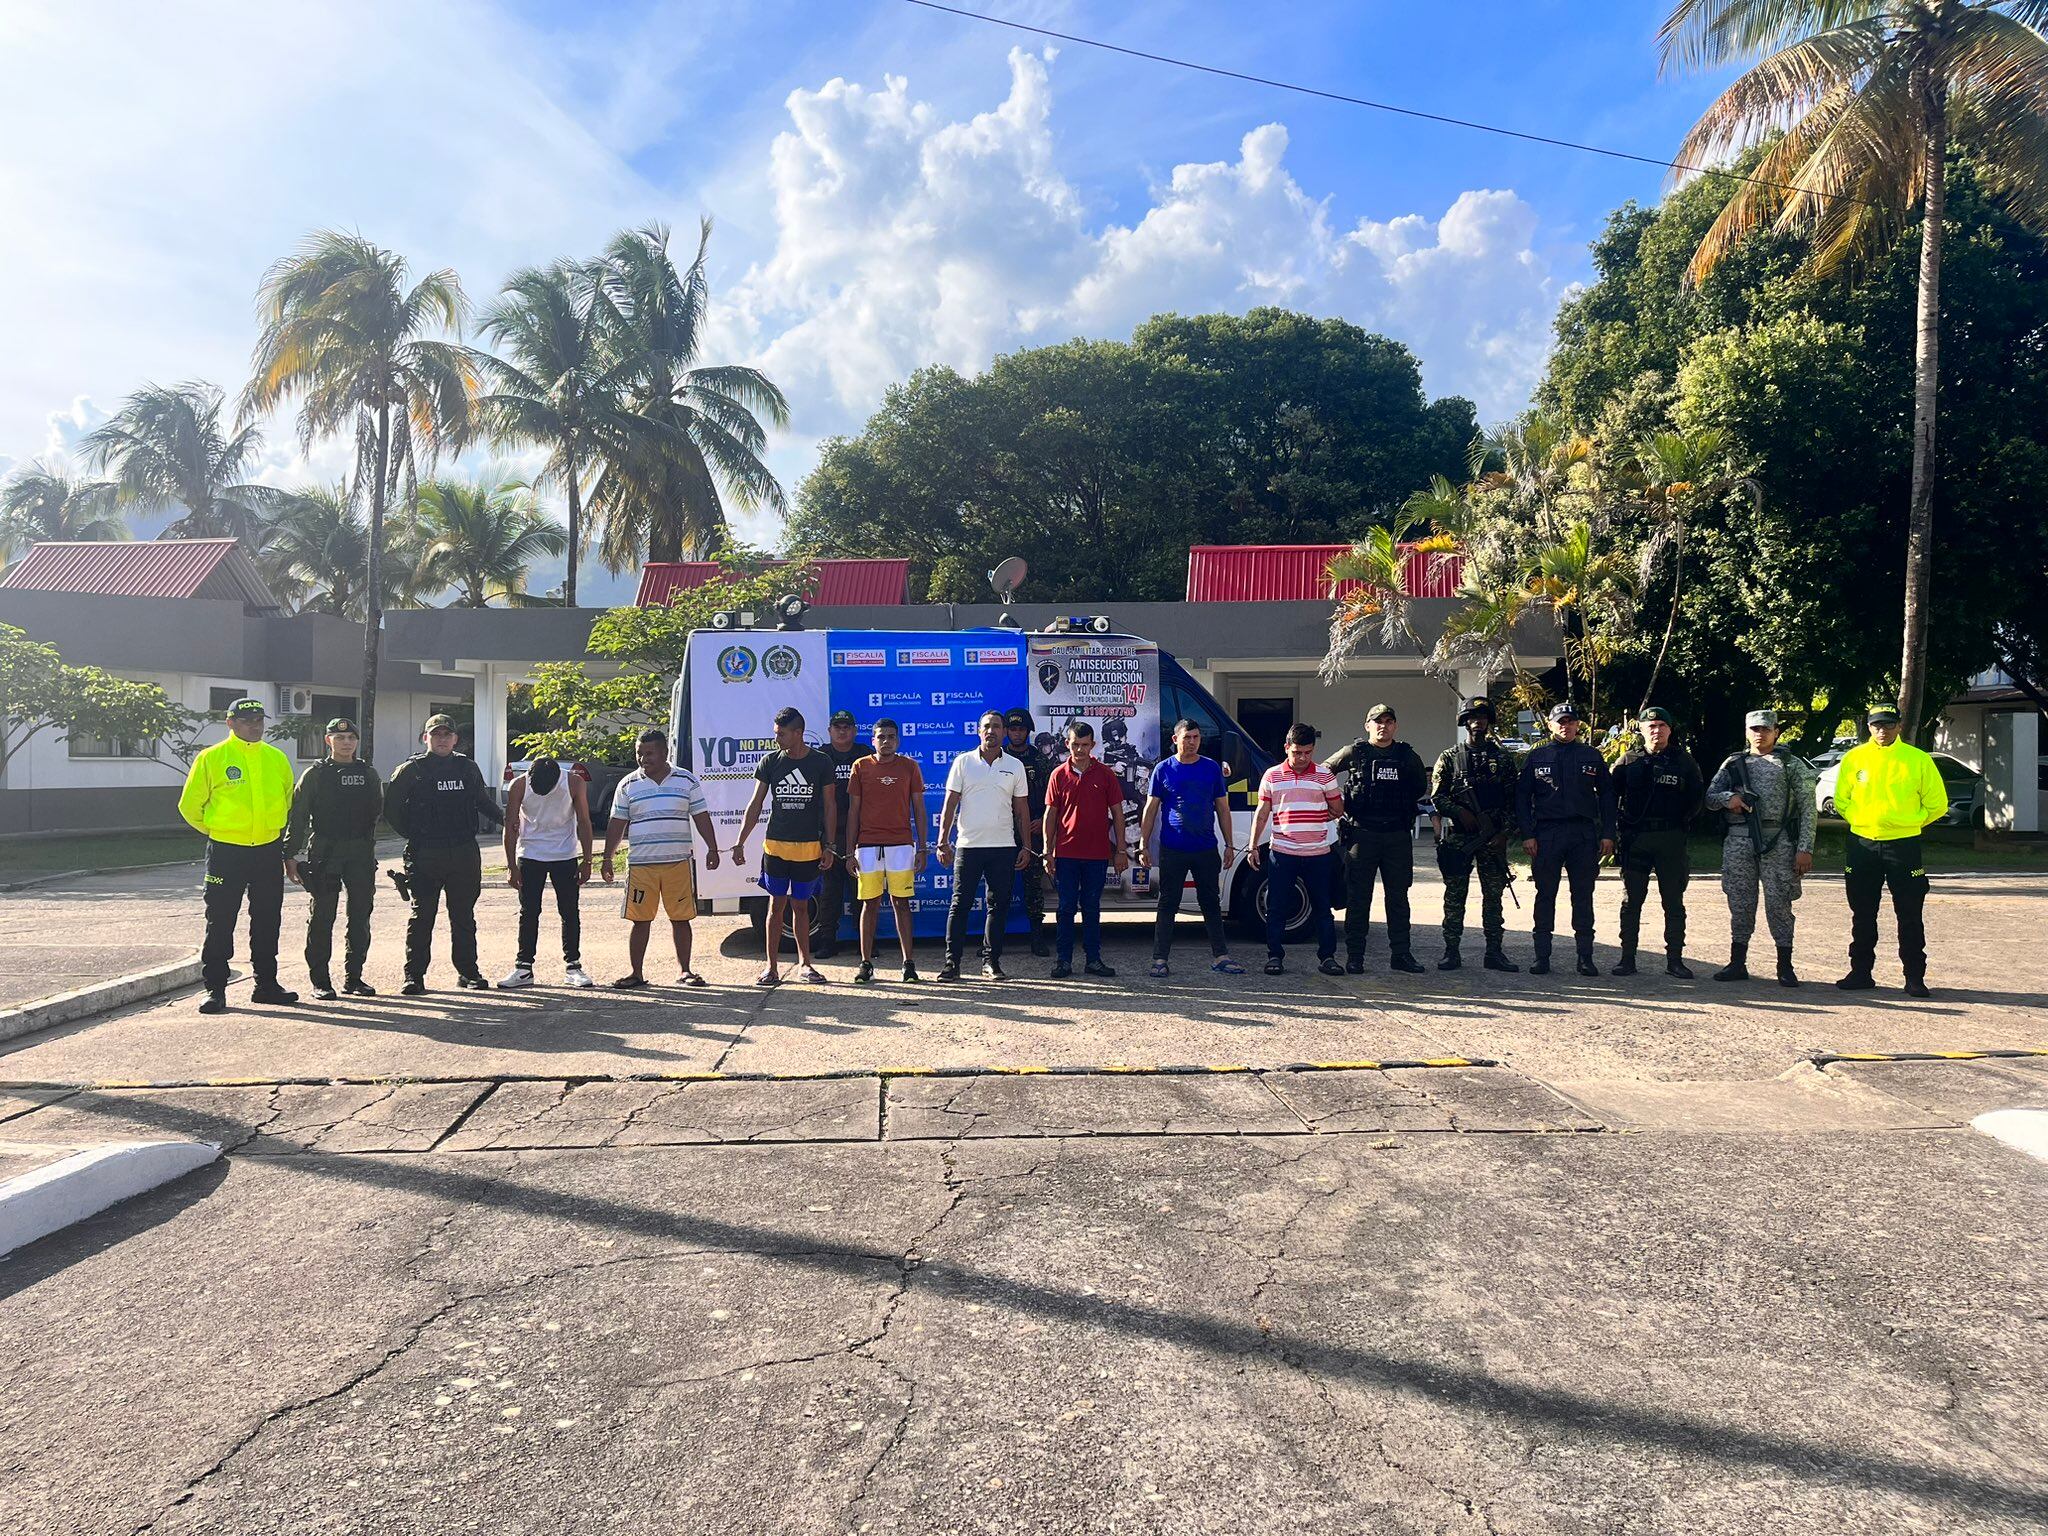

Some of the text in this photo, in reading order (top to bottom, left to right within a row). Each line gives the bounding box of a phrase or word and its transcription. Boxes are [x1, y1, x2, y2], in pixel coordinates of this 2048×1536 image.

[1101, 647, 1136, 655] CASANARE
[1069, 659, 1139, 671] ANTISECUESTRO
[1066, 671, 1143, 683] Y ANTIEXTORSIÓN
[883, 692, 921, 700] FISCALÍA
[1077, 684, 1146, 704] YO NO PAGO 147
[1049, 706, 1076, 715] CELULAR
[1554, 704, 1573, 714] CTI
[916, 721, 955, 729] FISCALÍA
[698, 736, 780, 768] YO NO PAG
[341, 775, 365, 786] GOES
[437, 780, 465, 791] GAULA
[775, 783, 814, 795] adidas
[708, 808, 734, 817] irección
[632, 888, 645, 904] 17
